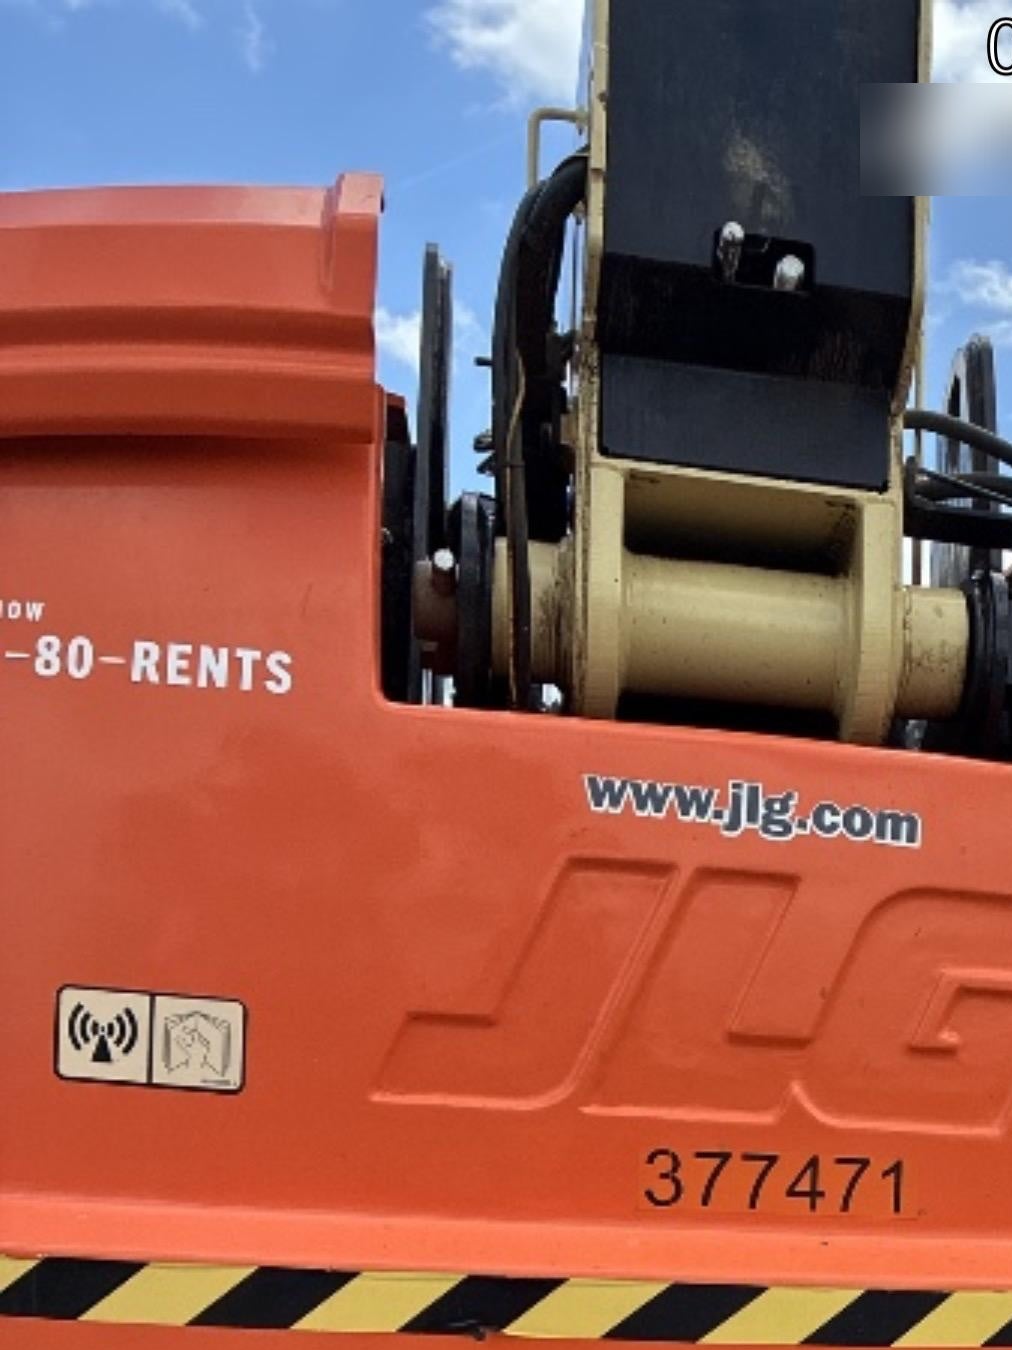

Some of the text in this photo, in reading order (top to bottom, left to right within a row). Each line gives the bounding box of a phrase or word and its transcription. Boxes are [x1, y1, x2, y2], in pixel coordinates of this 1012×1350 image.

[0, 600, 45, 621] OW
[584, 774, 922, 846] www.jlg.com
[643, 1149, 905, 1213] 377471
